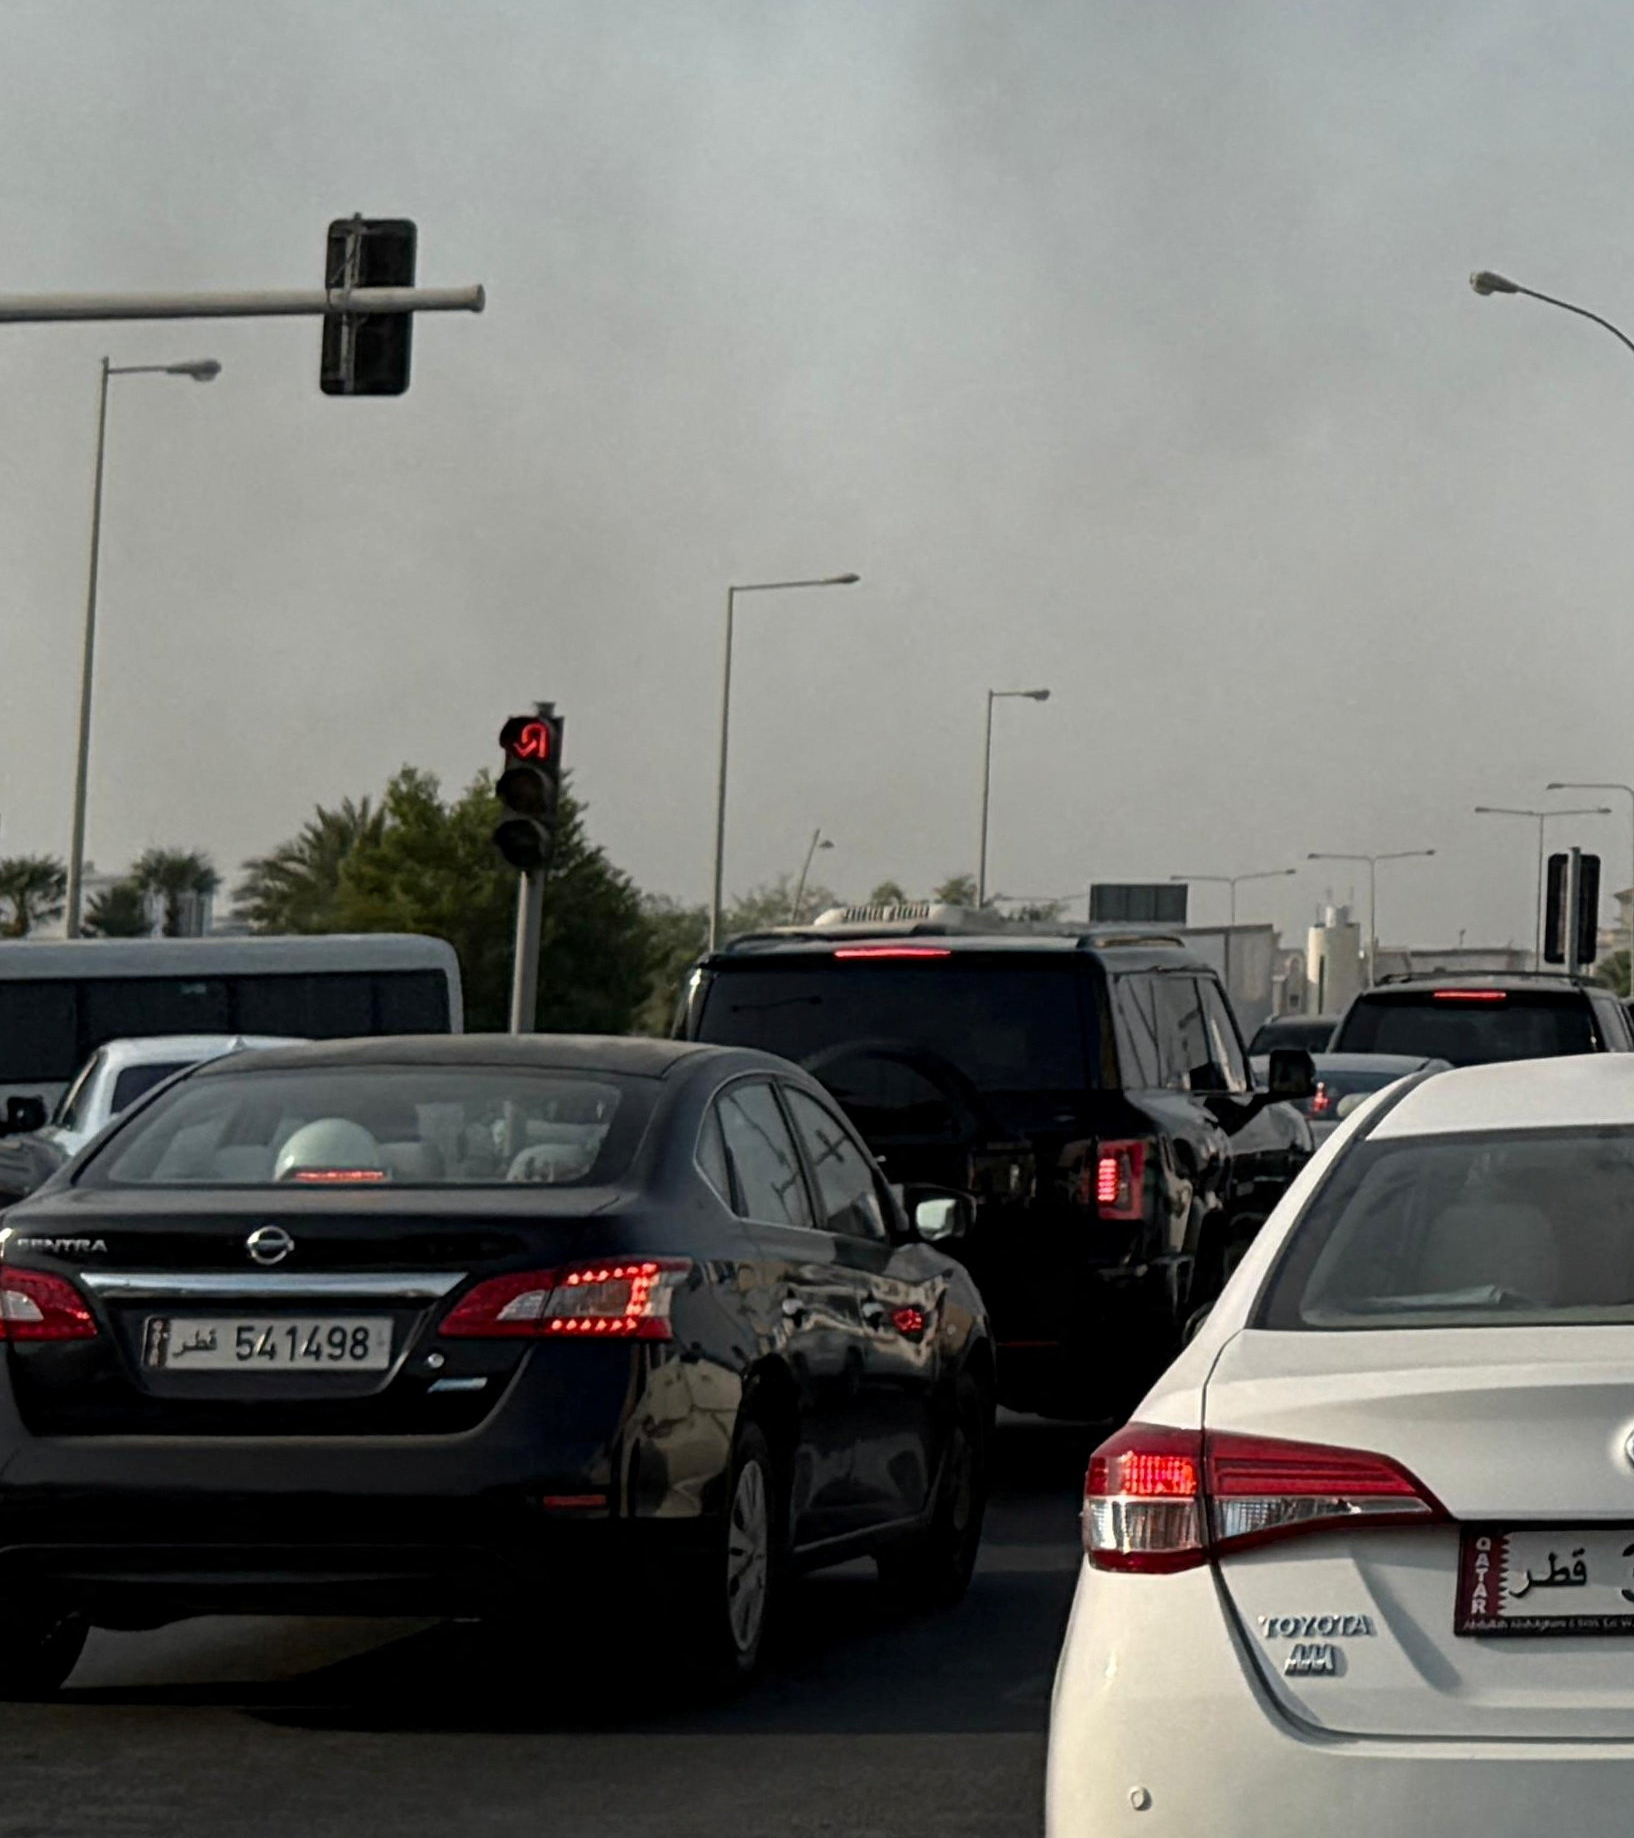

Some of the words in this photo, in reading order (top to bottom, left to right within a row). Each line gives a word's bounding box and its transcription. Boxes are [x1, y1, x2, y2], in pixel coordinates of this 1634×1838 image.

[172, 1328, 217, 1358] قطر
[235, 1324, 370, 1362] 541498
[1471, 1536, 1492, 1614] QATAR
[1508, 1548, 1588, 1598] قطر
[1258, 1615, 1374, 1638] TOYOTA
